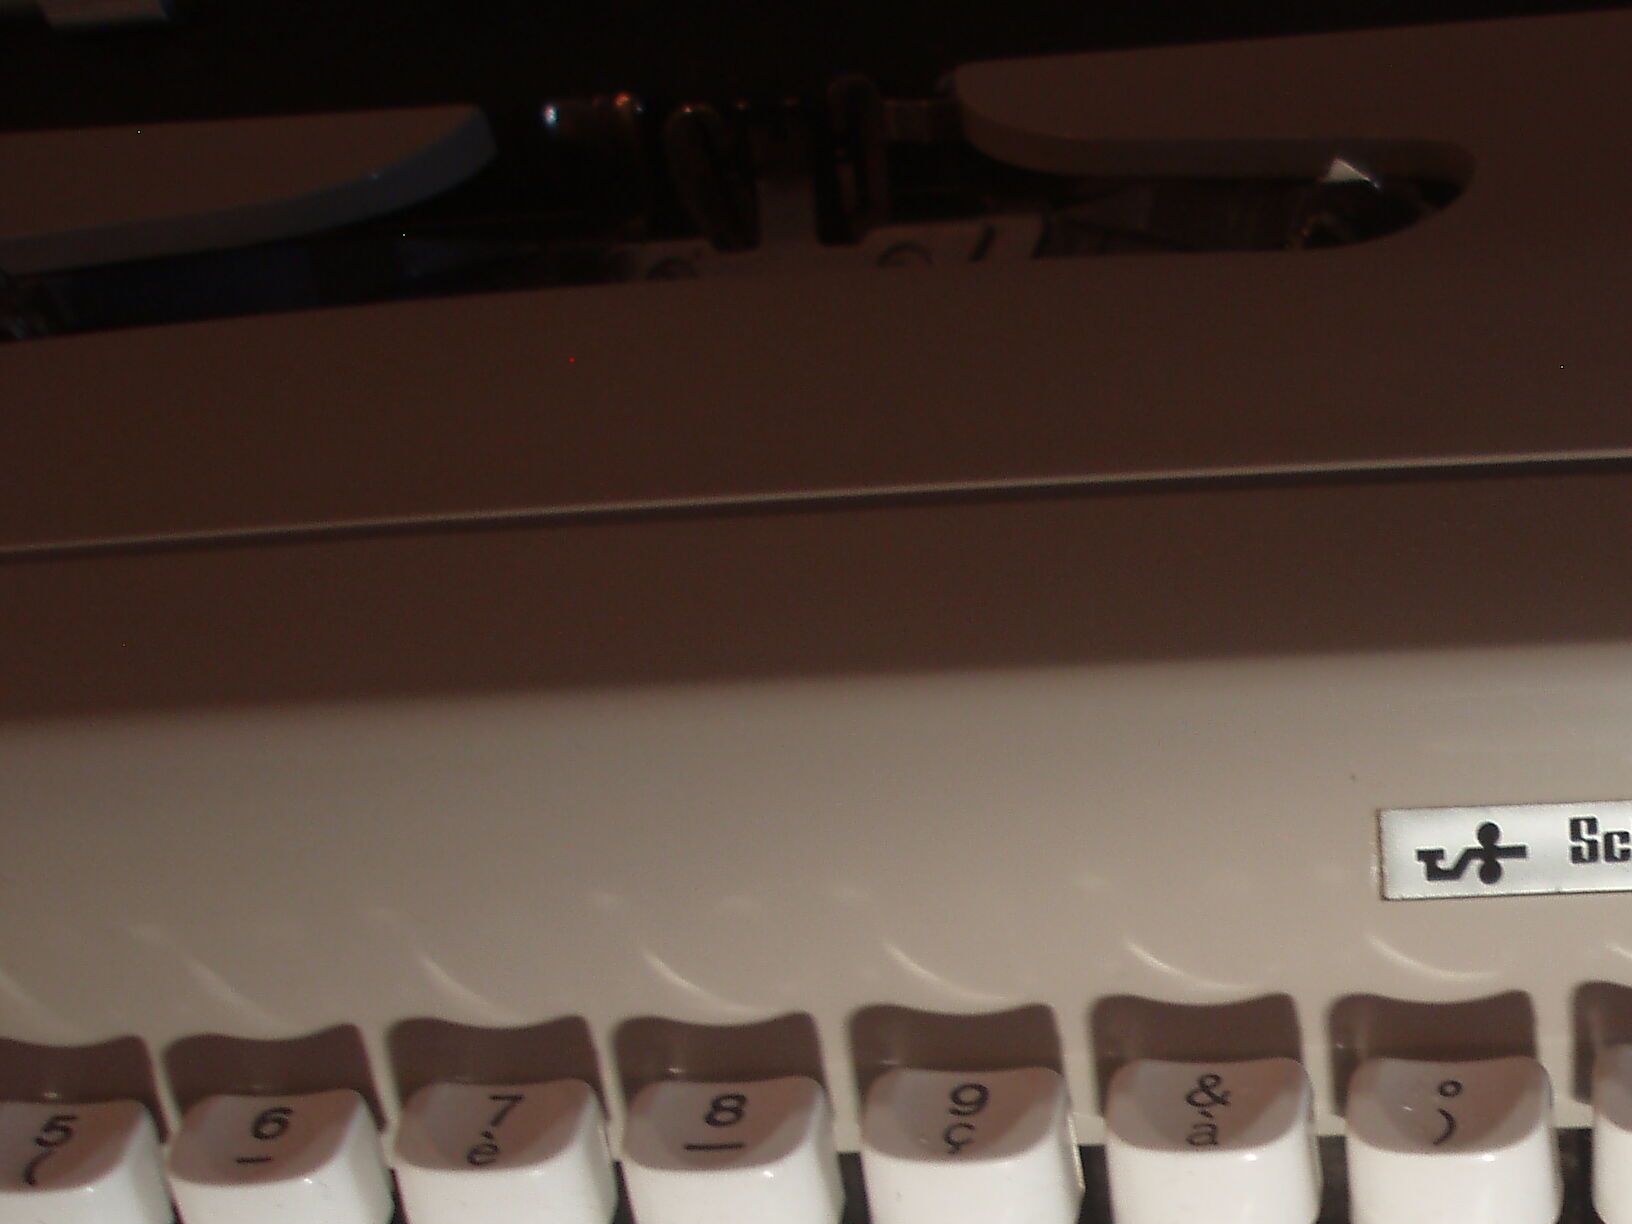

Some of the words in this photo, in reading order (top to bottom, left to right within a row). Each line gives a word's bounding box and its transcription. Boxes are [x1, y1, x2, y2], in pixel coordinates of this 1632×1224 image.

[950, 1083, 989, 1119] 9
[1186, 1075, 1230, 1108] &
[252, 1107, 292, 1139] 6
[488, 1095, 523, 1128] 7
[705, 1094, 747, 1126] 8
[34, 1115, 75, 1145] 5
